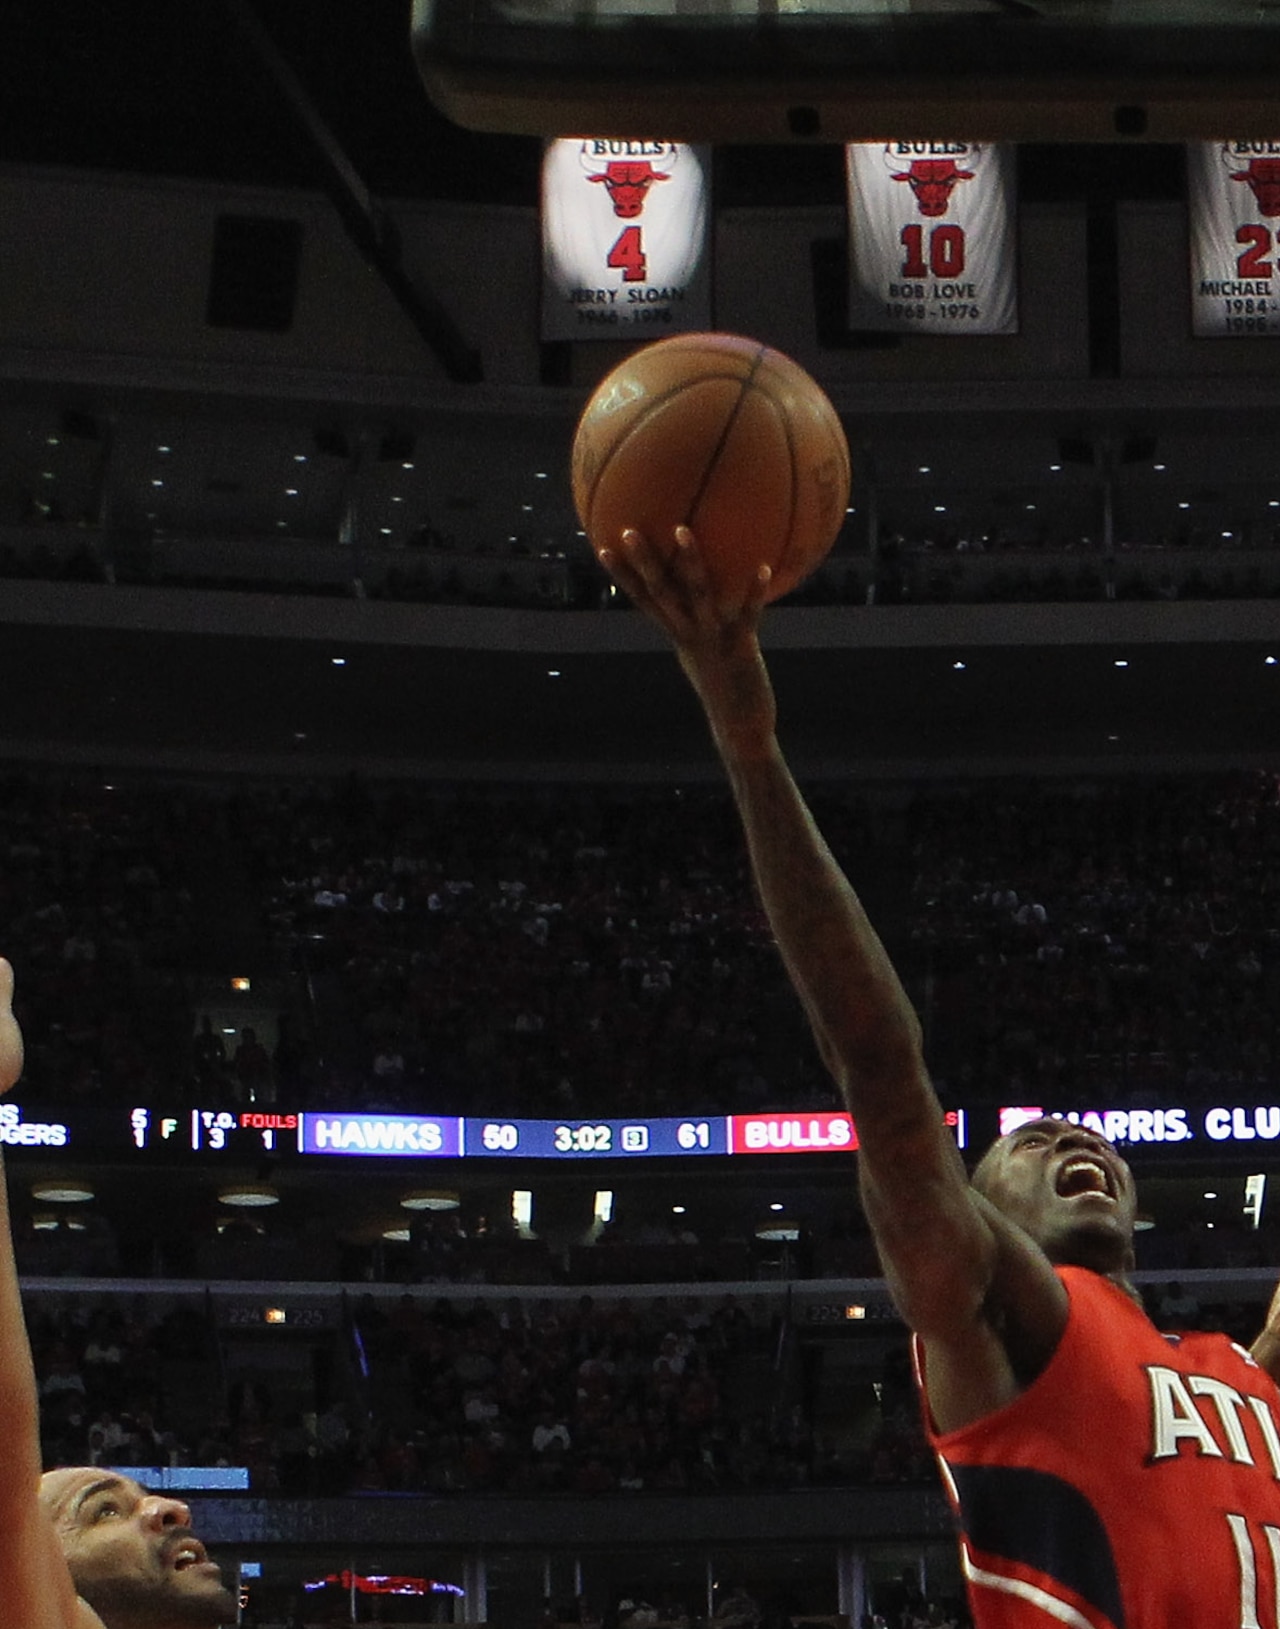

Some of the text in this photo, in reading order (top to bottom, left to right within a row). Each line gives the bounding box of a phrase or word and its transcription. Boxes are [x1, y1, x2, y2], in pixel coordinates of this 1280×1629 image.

[594, 140, 663, 154] BULLS
[607, 226, 646, 281] 4
[901, 224, 964, 277] 10
[571, 287, 684, 303] JERRY SLOAN
[889, 284, 976, 299] BOB LOVE
[1200, 280, 1271, 296] MICHAEL
[161, 1118, 177, 1139] F
[242, 1113, 298, 1128] FOULS
[0, 1123, 67, 1146] GERS
[208, 1129, 226, 1149] 3
[261, 1129, 274, 1150] 1
[315, 1120, 442, 1151] HAWKS
[482, 1124, 518, 1150] 50
[554, 1126, 612, 1151] 3:02
[677, 1122, 709, 1149] 61
[744, 1119, 852, 1148] BULLS
